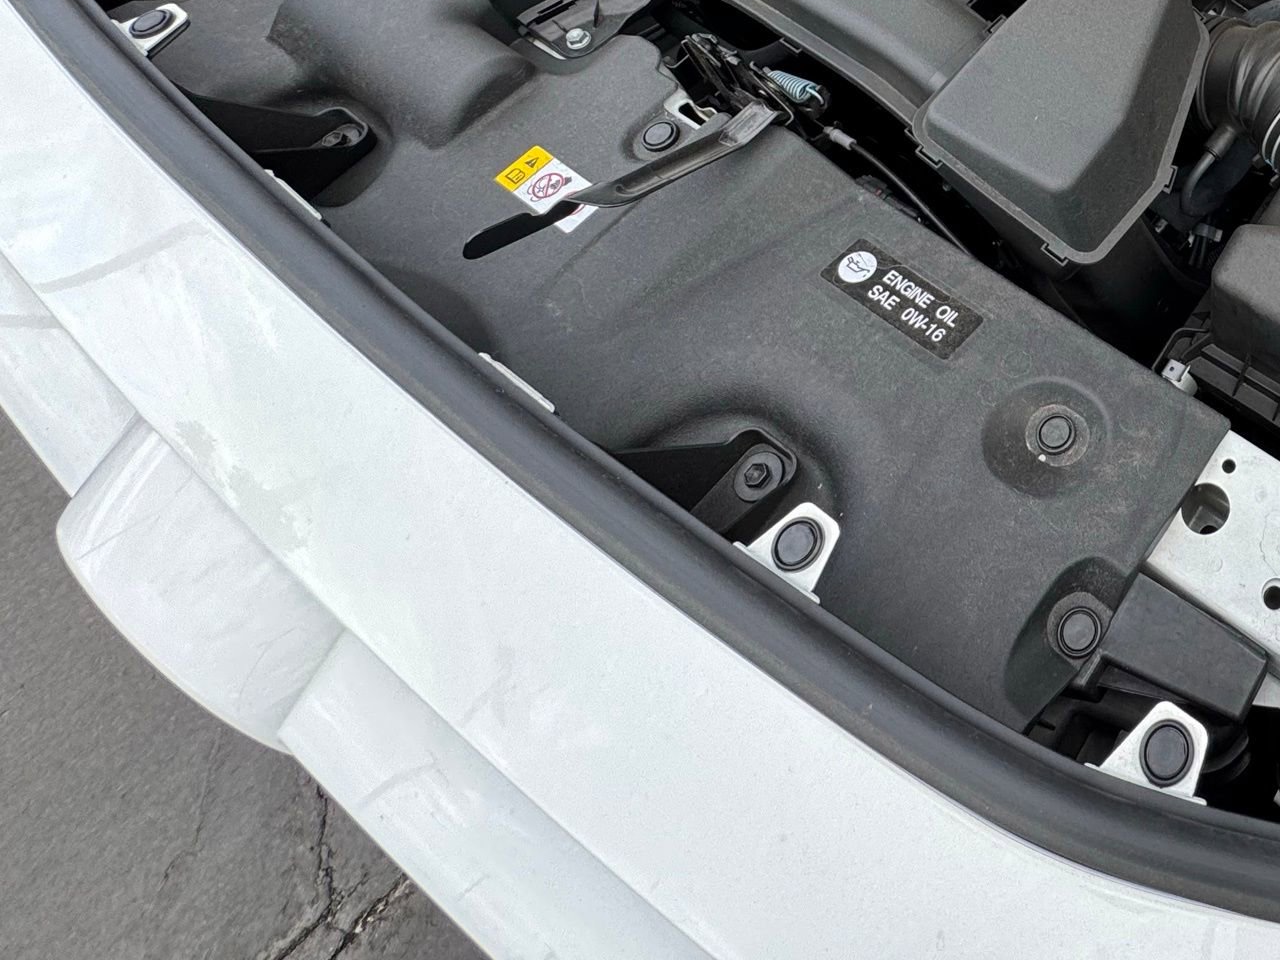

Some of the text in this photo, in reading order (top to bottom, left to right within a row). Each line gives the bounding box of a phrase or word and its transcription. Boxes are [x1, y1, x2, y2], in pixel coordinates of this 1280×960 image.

[867, 285, 946, 342] SAE 0W-16
[882, 270, 960, 328] ENGINE OIL
